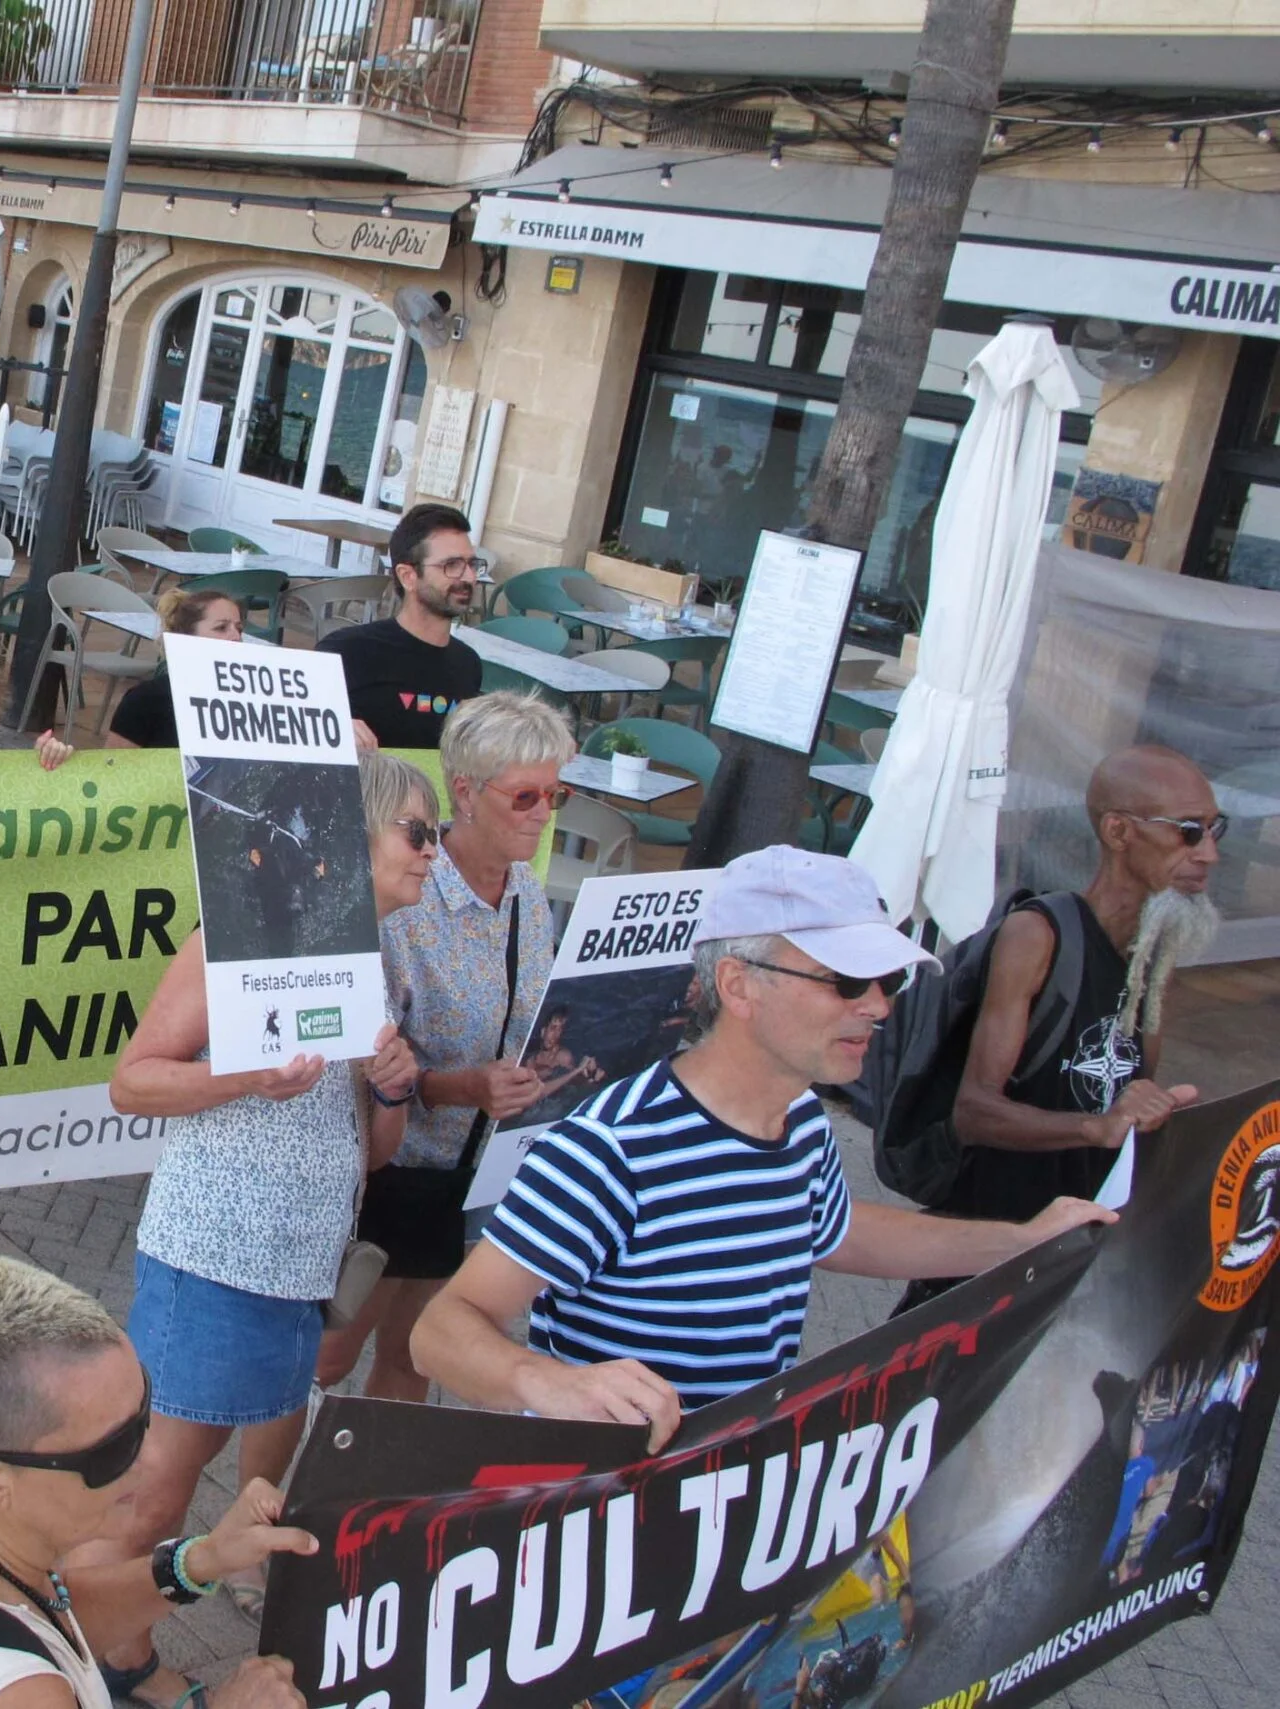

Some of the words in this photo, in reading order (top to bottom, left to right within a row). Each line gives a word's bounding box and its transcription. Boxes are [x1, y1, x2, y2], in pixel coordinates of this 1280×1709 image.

[350, 222, 431, 256] Piri-Piri
[518, 220, 588, 241] ESTRELLA
[590, 227, 644, 248] DAMM
[1171, 276, 1280, 324] CALIMA
[214, 660, 274, 698] ESTO
[279, 667, 309, 700] ES
[189, 697, 342, 749] TORMENTO
[21, 888, 200, 965] PAR
[612, 892, 671, 921] ESTO
[672, 889, 703, 915] ES
[576, 919, 701, 963] BARBARI
[242, 970, 354, 993] FiestasCrueles.org
[424, 1397, 939, 1709] CULTURA
[318, 1581, 400, 1690] NO
[987, 1561, 1206, 1702] TIERMISSHANDLUNG
